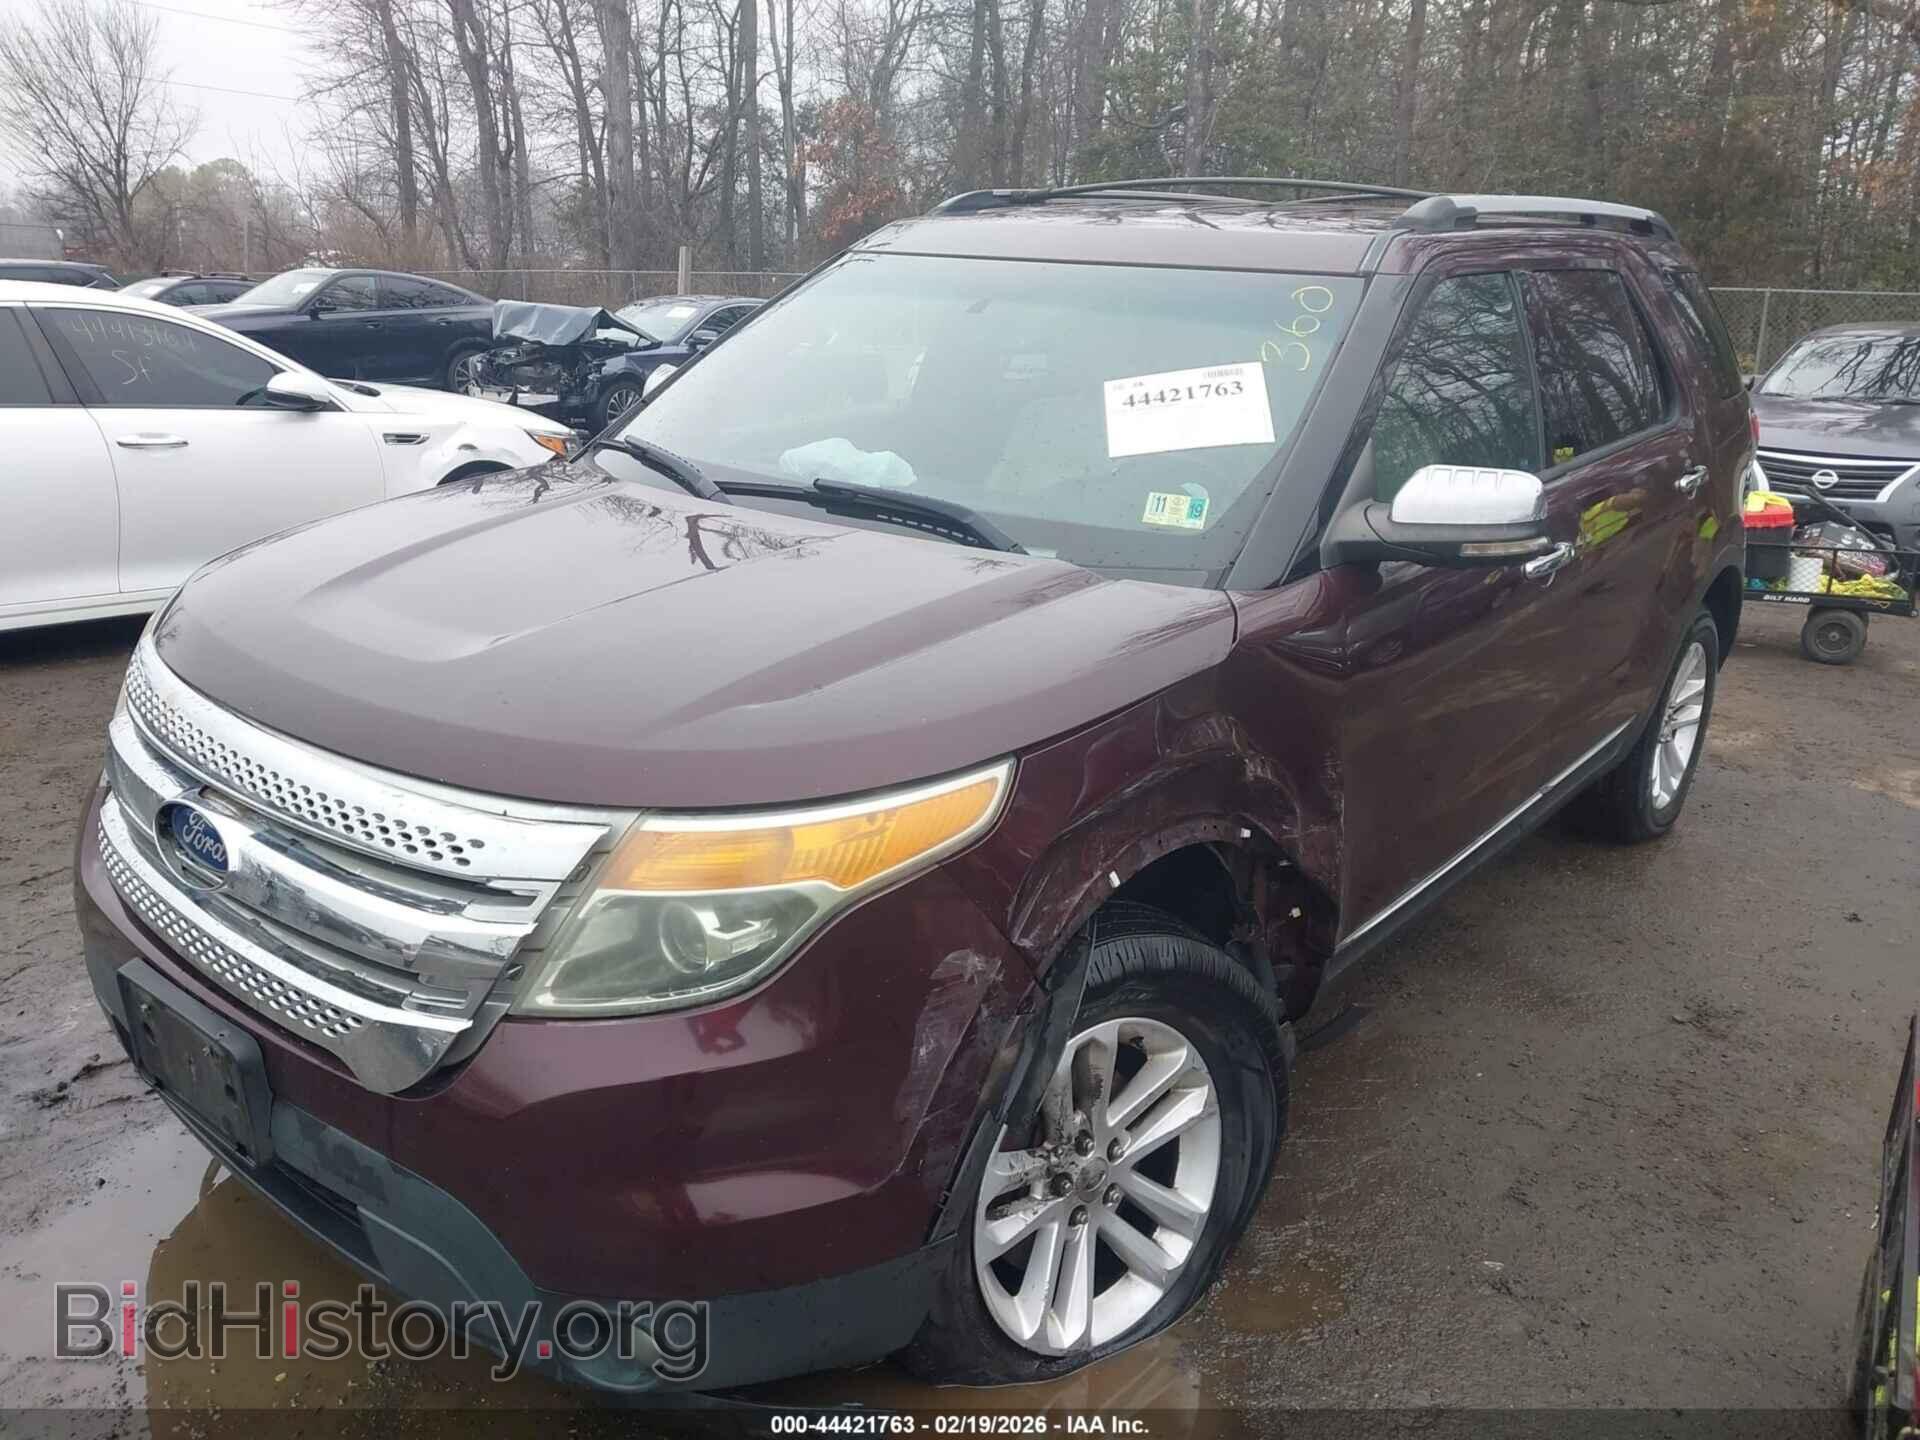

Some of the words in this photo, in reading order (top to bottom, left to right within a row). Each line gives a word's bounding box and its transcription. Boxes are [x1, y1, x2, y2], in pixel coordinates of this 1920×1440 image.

[1122, 381, 1244, 406] 44421763
[1153, 495, 1168, 513] 11
[1190, 502, 1205, 519] 19
[182, 811, 226, 862] Ford
